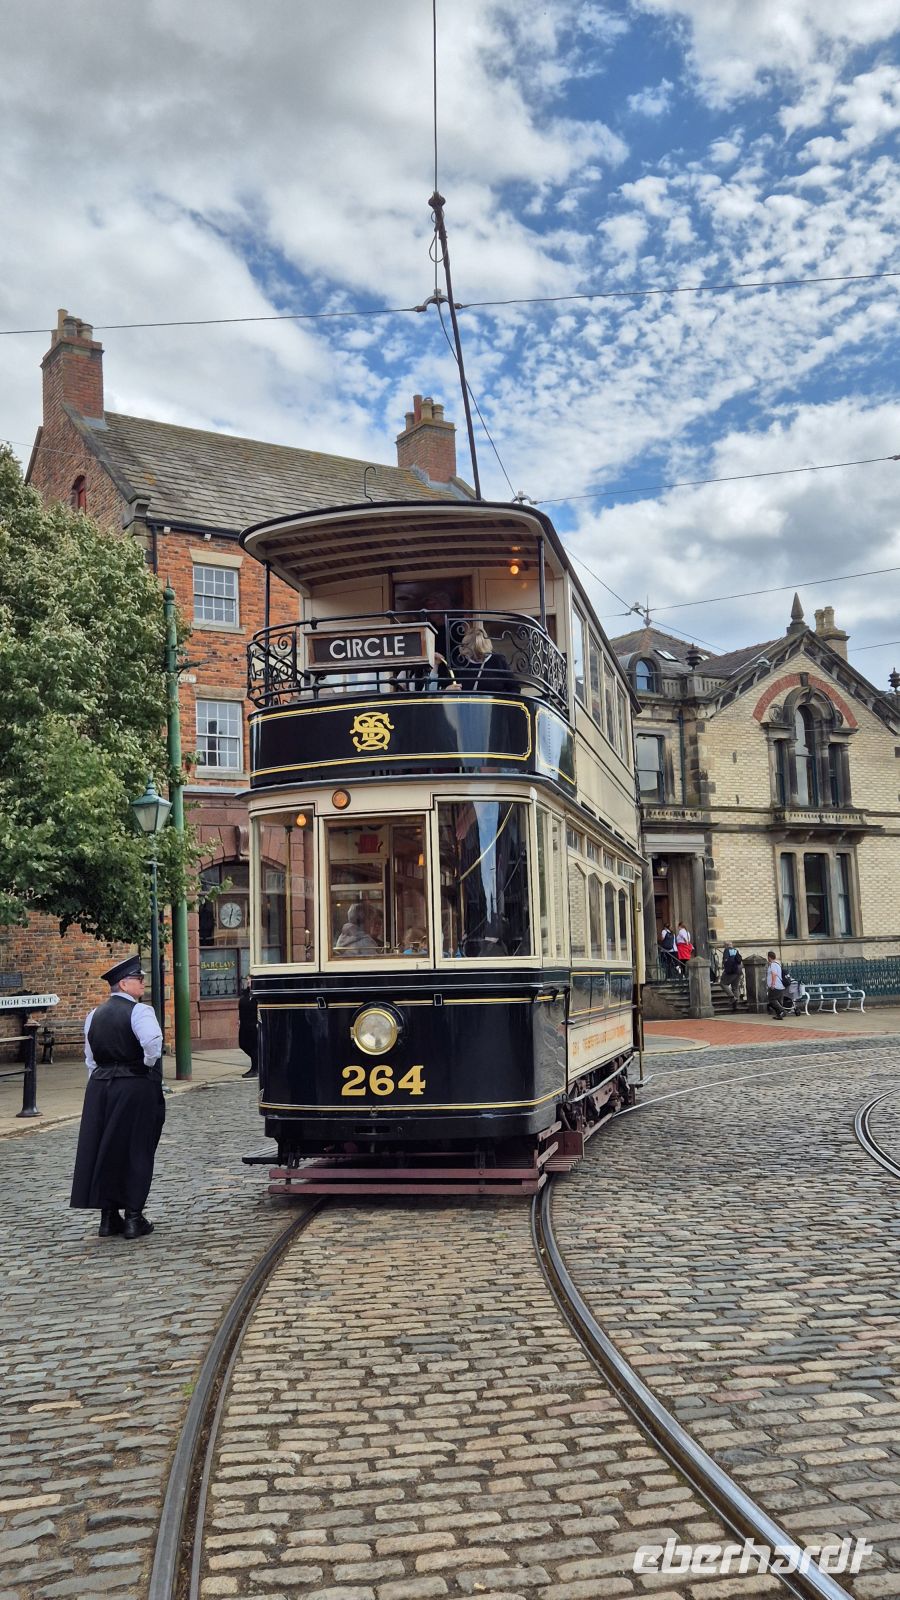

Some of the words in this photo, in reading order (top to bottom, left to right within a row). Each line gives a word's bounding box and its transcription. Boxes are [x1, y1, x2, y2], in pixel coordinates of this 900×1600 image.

[329, 635, 405, 659] CIRCLE
[200, 960, 236, 969] BARCLAYS
[21, 996, 53, 1005] STREET
[341, 1064, 426, 1096] 264
